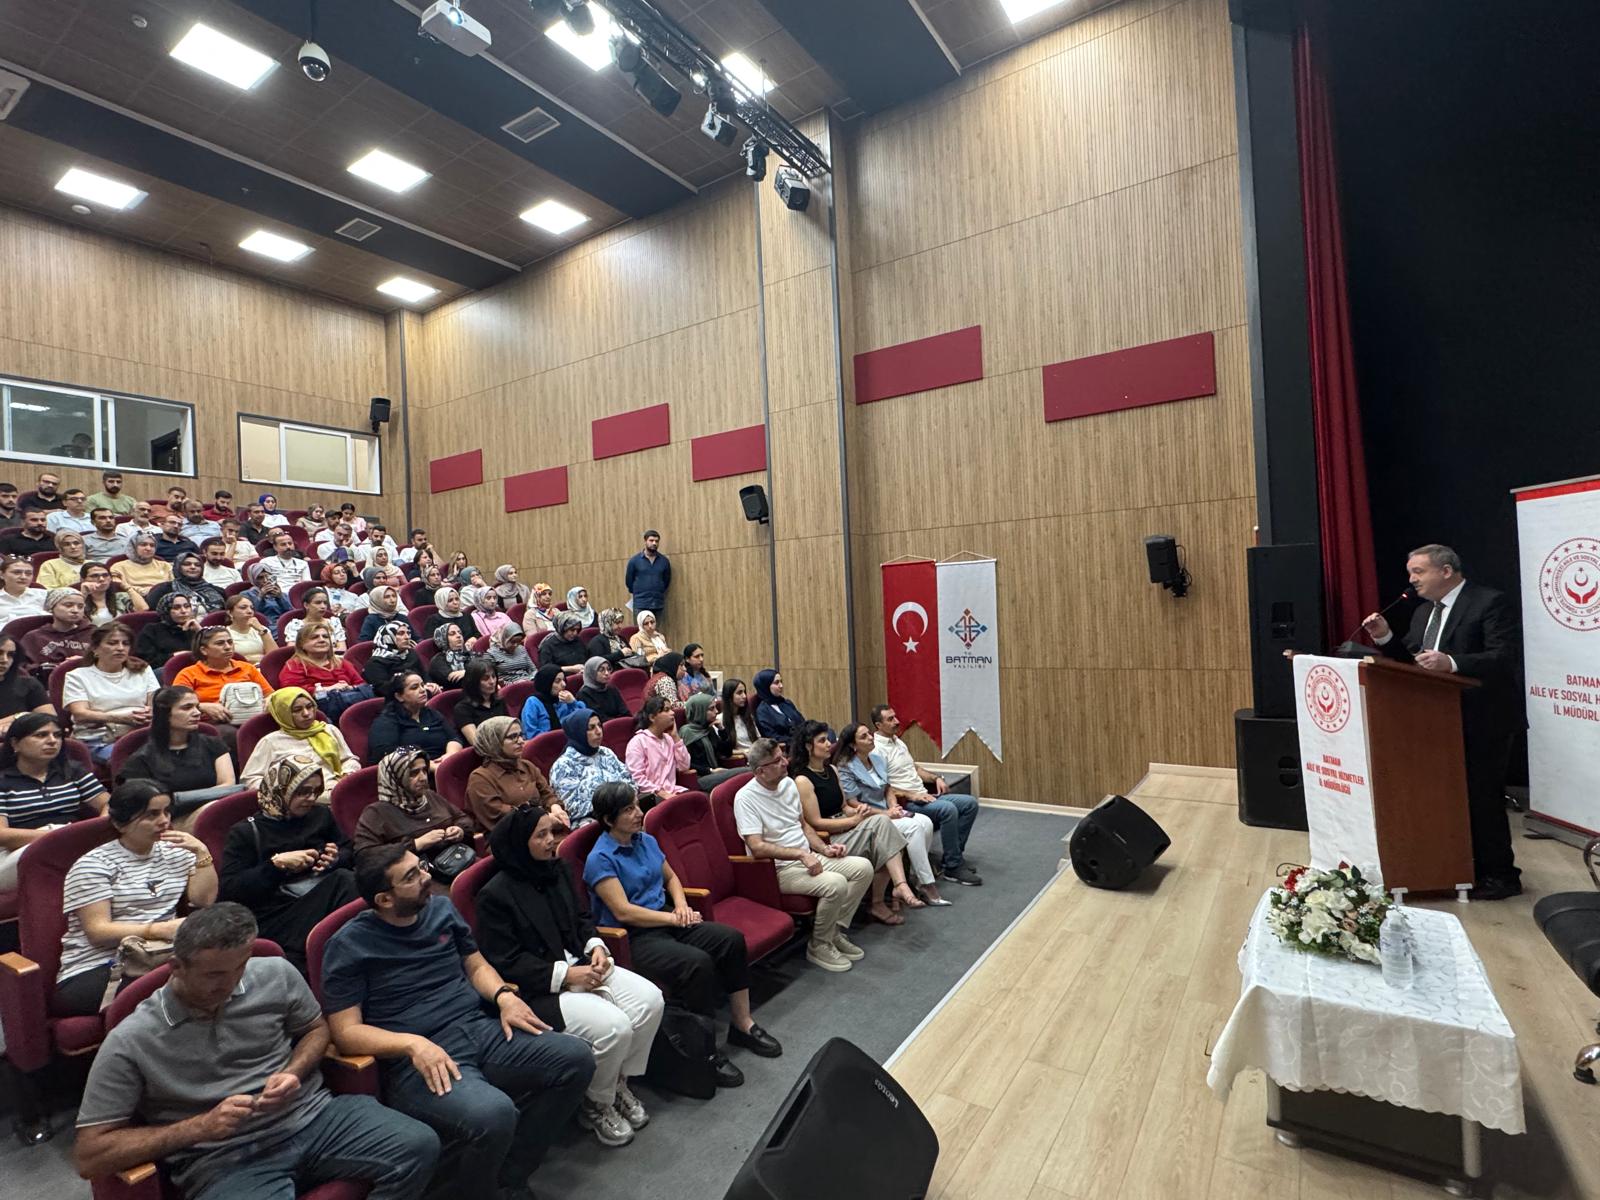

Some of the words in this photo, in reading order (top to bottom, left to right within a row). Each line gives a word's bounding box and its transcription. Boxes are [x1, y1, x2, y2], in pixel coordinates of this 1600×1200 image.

[945, 655, 992, 664] BATMAN
[1530, 684, 1547, 698] AİLE
[1548, 688, 1559, 700] VE
[1561, 690, 1593, 704] SOSYAL
[1553, 702, 1562, 716] İL
